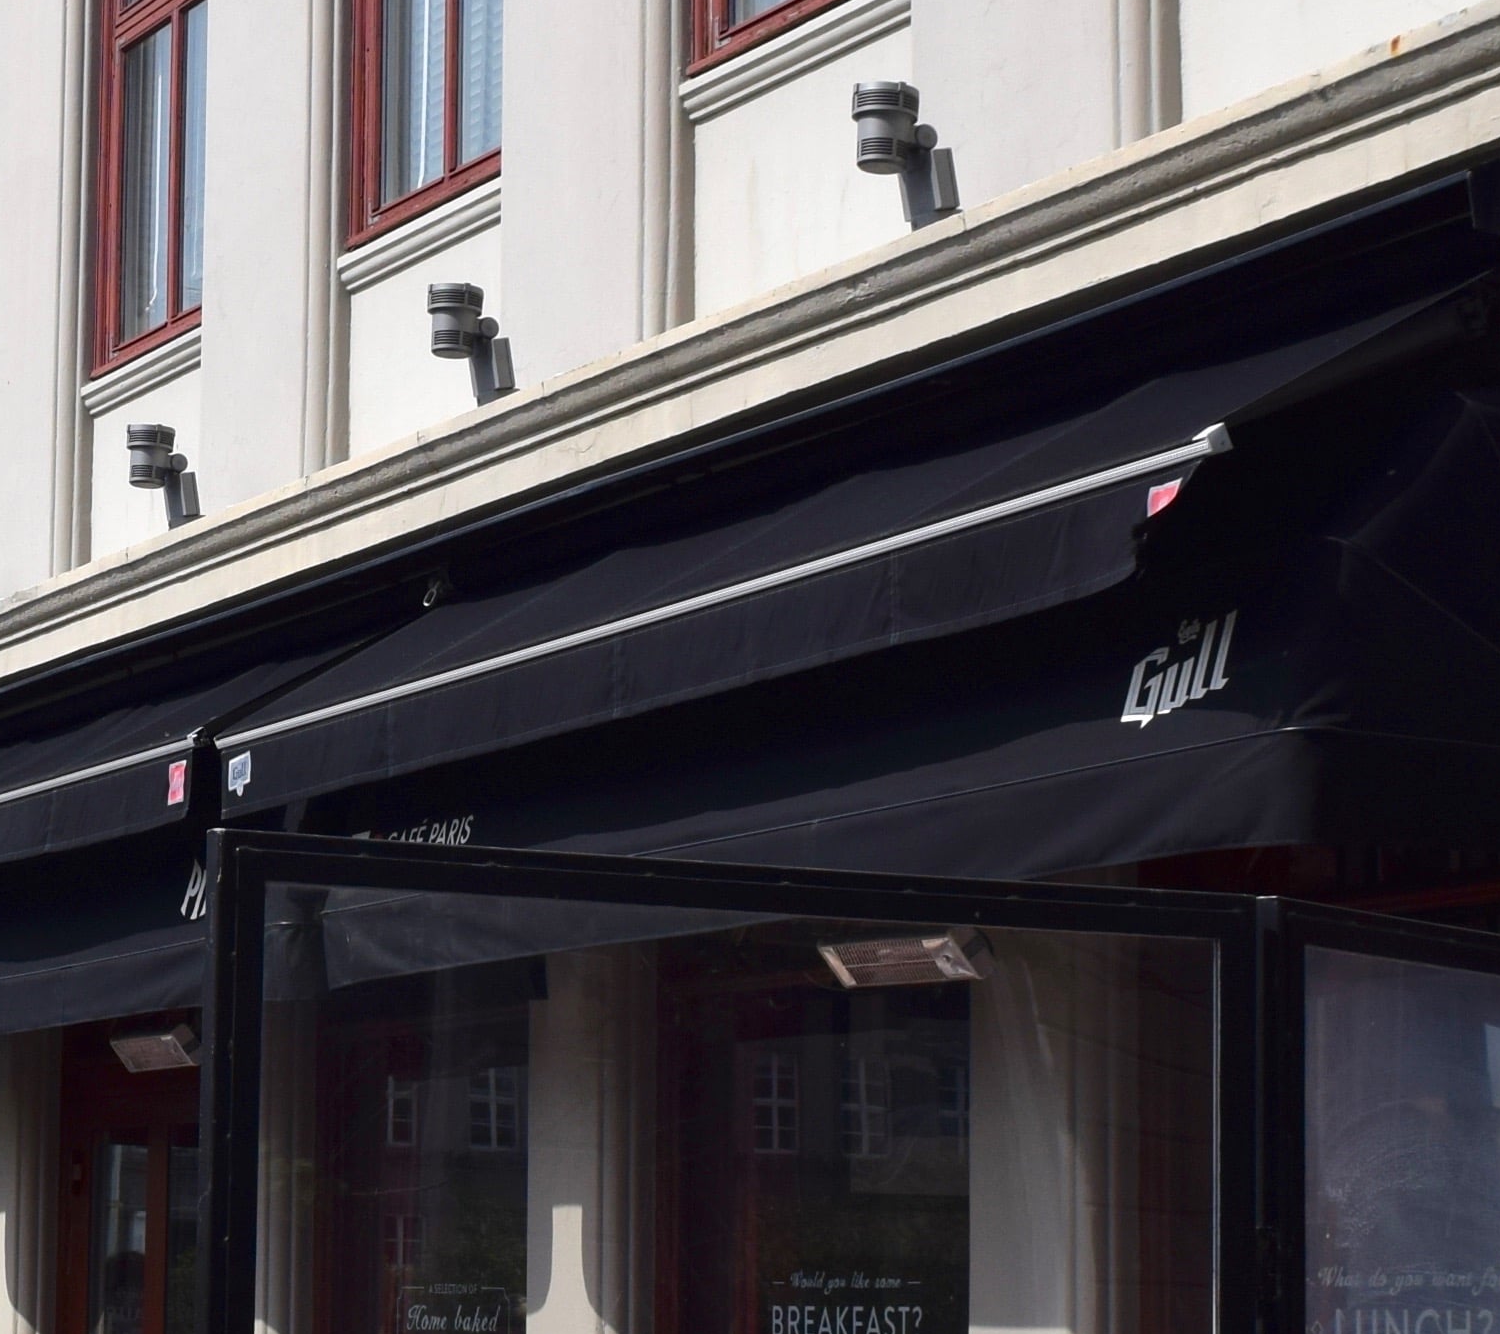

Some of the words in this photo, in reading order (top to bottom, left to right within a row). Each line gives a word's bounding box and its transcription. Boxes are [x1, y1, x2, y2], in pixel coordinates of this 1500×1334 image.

[1120, 608, 1239, 730] Gull
[428, 814, 475, 846] PARIS
[406, 1304, 449, 1331] Home
[453, 1304, 501, 1333] baked
